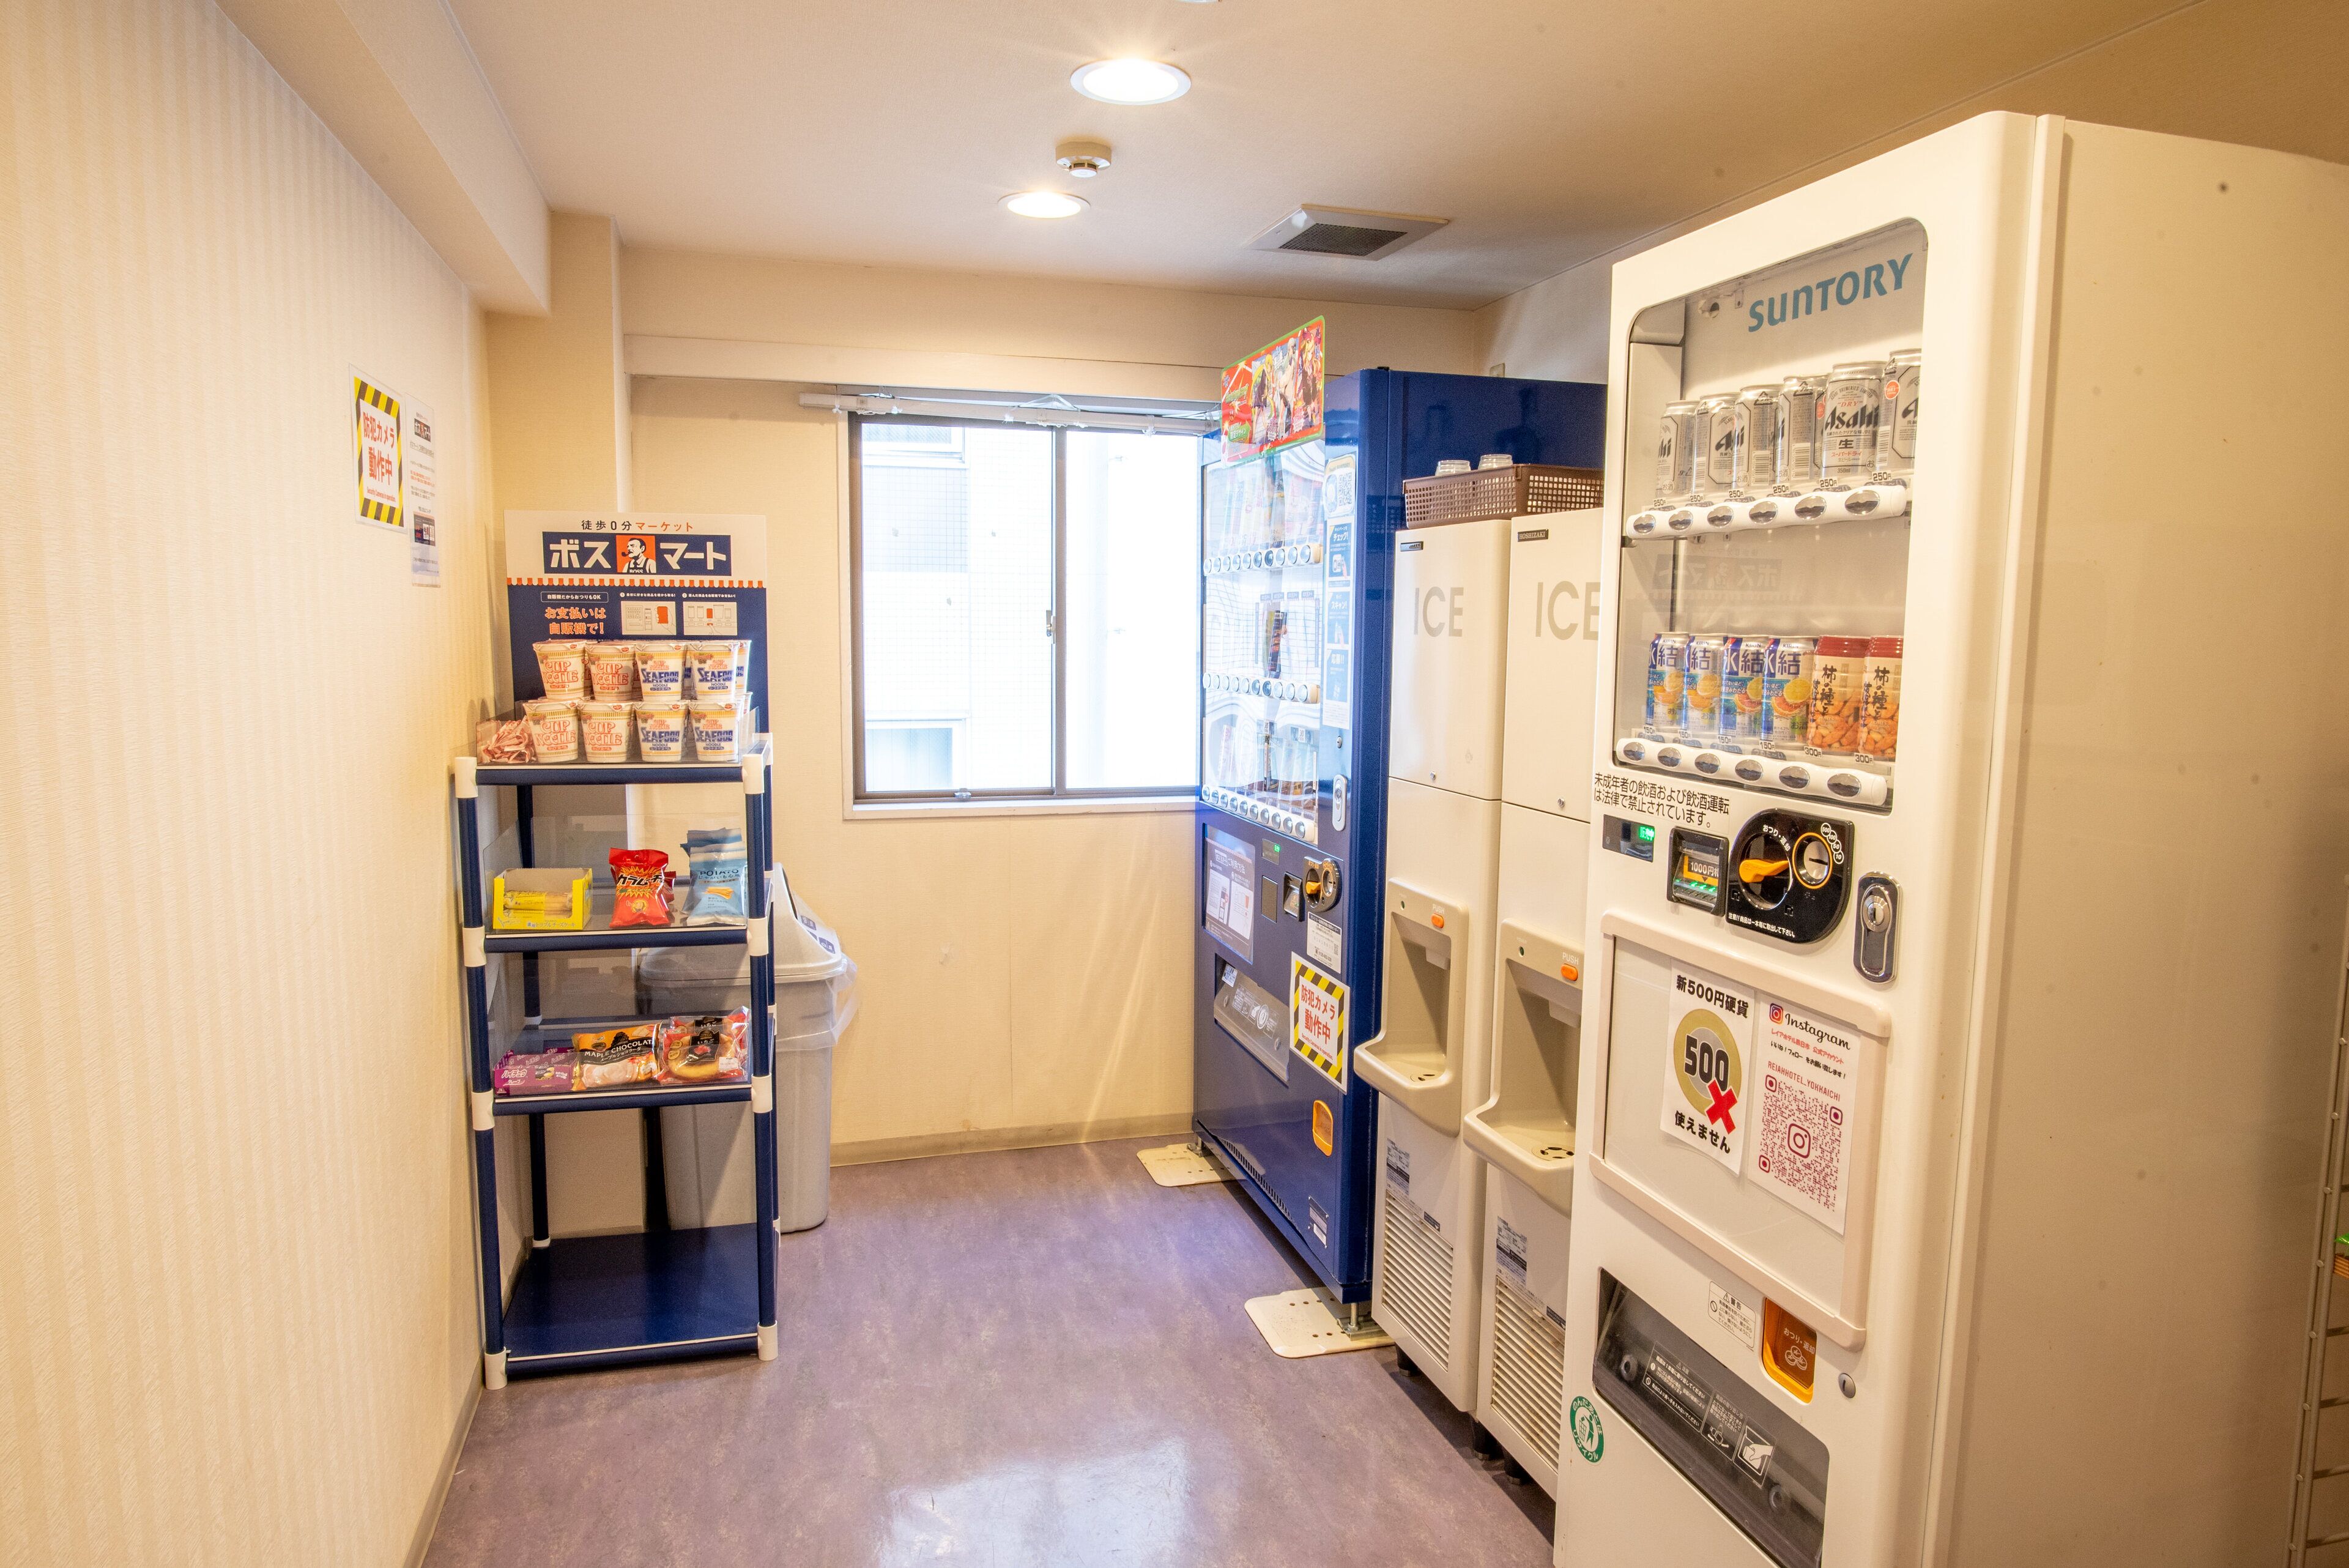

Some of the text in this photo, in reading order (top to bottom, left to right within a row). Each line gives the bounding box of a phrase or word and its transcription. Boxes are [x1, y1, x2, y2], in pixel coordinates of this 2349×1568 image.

[1748, 253, 1913, 332] SUNTORY
[1825, 404, 1880, 430] Asahi
[363, 412, 395, 448] 防犯カメラ
[1839, 439, 1854, 448] 生
[368, 447, 393, 485] 動作中
[1820, 478, 1838, 488] 250円
[1872, 472, 1891, 481] 250円
[1663, 483, 1674, 491] お酒
[1773, 485, 1789, 494] 250円
[1519, 531, 1546, 540] HOSHIZAKI
[549, 538, 727, 570] ボス マート
[544, 607, 607, 619] お支払いは
[1414, 586, 1464, 637] ICE
[1535, 581, 1601, 641] ICE
[549, 622, 604, 634] 自販機で!
[544, 661, 571, 672] CUP
[595, 663, 622, 674] CUP
[641, 668, 678, 683] SEAFOOD
[541, 720, 570, 734] CUP
[587, 721, 615, 734] CUP
[641, 726, 680, 743] SEAFOOD
[695, 726, 733, 742] SEAFOOD
[1760, 741, 1775, 750] 150円
[1805, 747, 1822, 757] 300円
[1855, 754, 1872, 764] 300円
[1595, 772, 1729, 816] 未成年者の飲酒および飲酒運転
[1594, 789, 1710, 828] は法律で禁止されています。
[1763, 824, 1791, 852] おつり・返却
[1432, 904, 1445, 914] PUSH
[1562, 952, 1579, 965] PUSH
[1301, 984, 1335, 1020] 防犯カメラ
[1676, 974, 1749, 1019] 新500円硬貨
[1305, 1008, 1330, 1045] 動作中
[1785, 1013, 1850, 1050] Instagram
[1772, 1028, 1844, 1065] レイアホテル四日市 公式アカウント
[1685, 1034, 1729, 1092] 500
[502, 1069, 527, 1079] ハイチュウ
[1768, 1061, 1841, 1102] REIAHHOTEL_YOKKAICHI
[1675, 1110, 1731, 1154] 使えません
[1731, 1297, 1742, 1310] 警告
[1784, 1328, 1815, 1354] おつり・返却
[1573, 1397, 1603, 1436] のんだあとは
[1572, 1429, 1598, 1462] リサイクル
